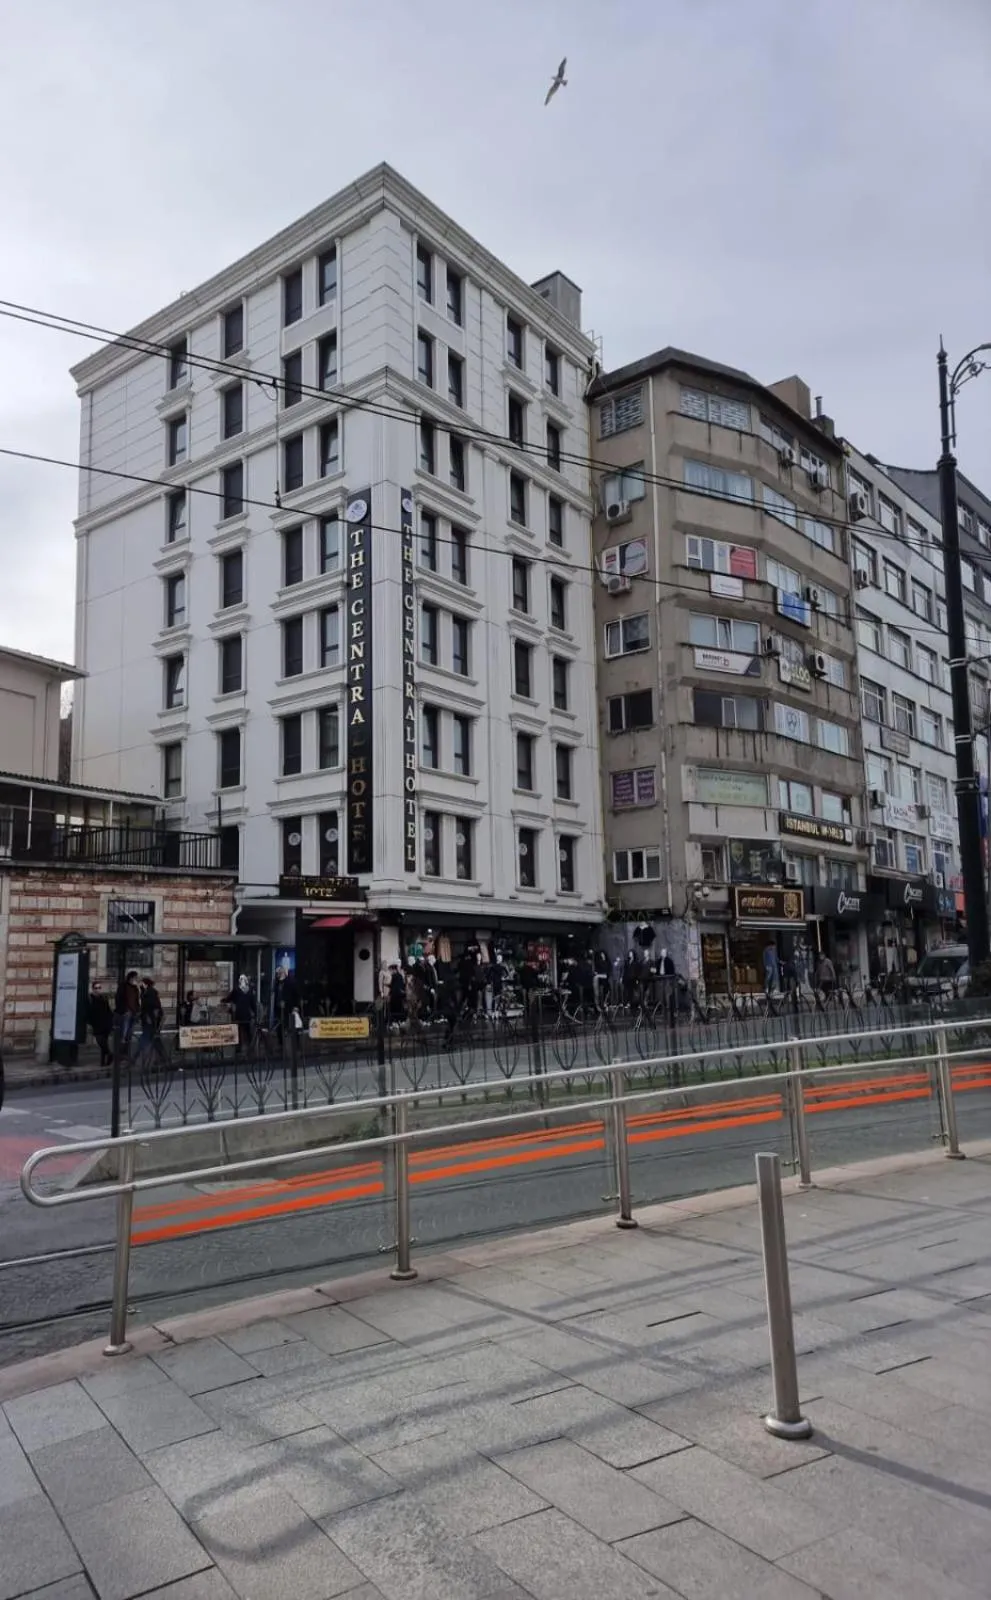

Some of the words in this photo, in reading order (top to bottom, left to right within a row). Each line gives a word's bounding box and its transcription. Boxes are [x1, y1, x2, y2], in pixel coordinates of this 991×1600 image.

[350, 528, 365, 590] THE
[403, 525, 413, 585] THE
[350, 599, 365, 746] CENTRAL
[404, 595, 415, 743] CENTRAL
[405, 756, 416, 862] HOTEL
[784, 816, 820, 835] ISTANBUL
